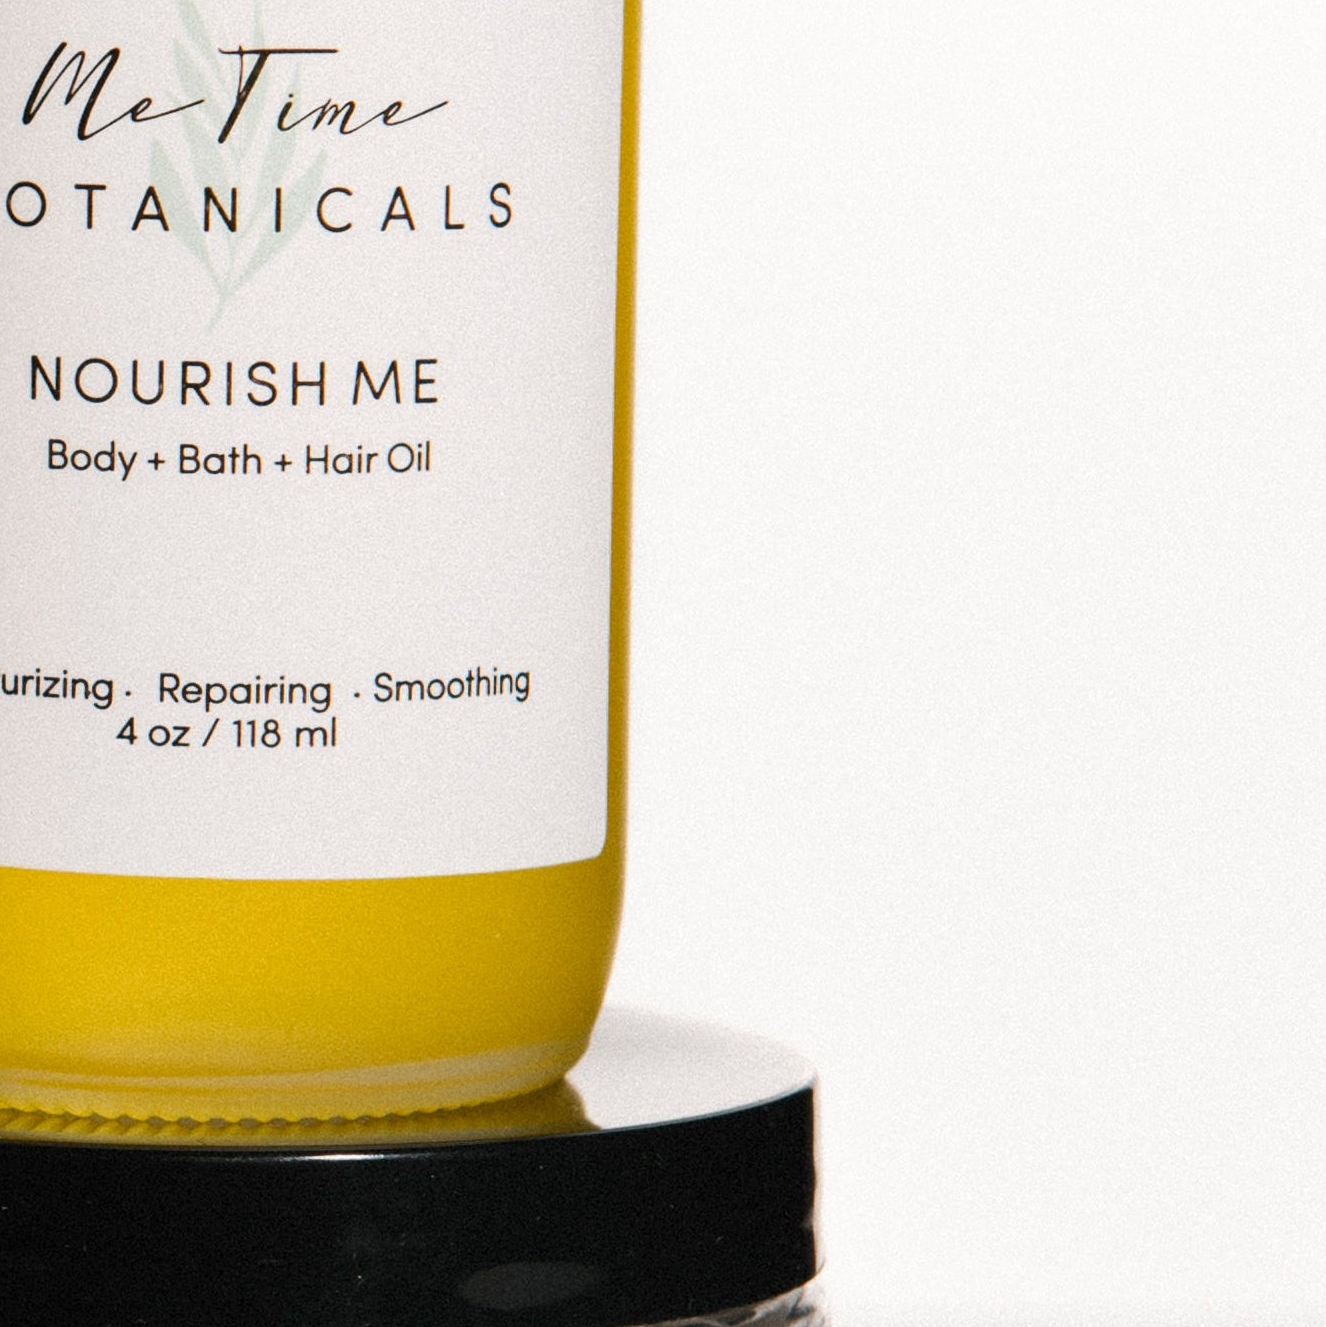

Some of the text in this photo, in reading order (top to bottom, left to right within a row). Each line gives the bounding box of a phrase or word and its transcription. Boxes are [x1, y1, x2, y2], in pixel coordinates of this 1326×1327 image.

[21, 41, 449, 143] Me Time
[30, 354, 438, 408] NOURISH ME
[47, 438, 138, 482] Body
[178, 443, 262, 475] Bath
[305, 444, 379, 475] Hair
[386, 440, 431, 474] Oil
[159, 671, 333, 713] Repairing
[372, 667, 532, 705] Smoothing
[115, 716, 138, 746] 4
[147, 724, 191, 748] oz
[232, 718, 282, 749] 118
[295, 716, 337, 748] ml
